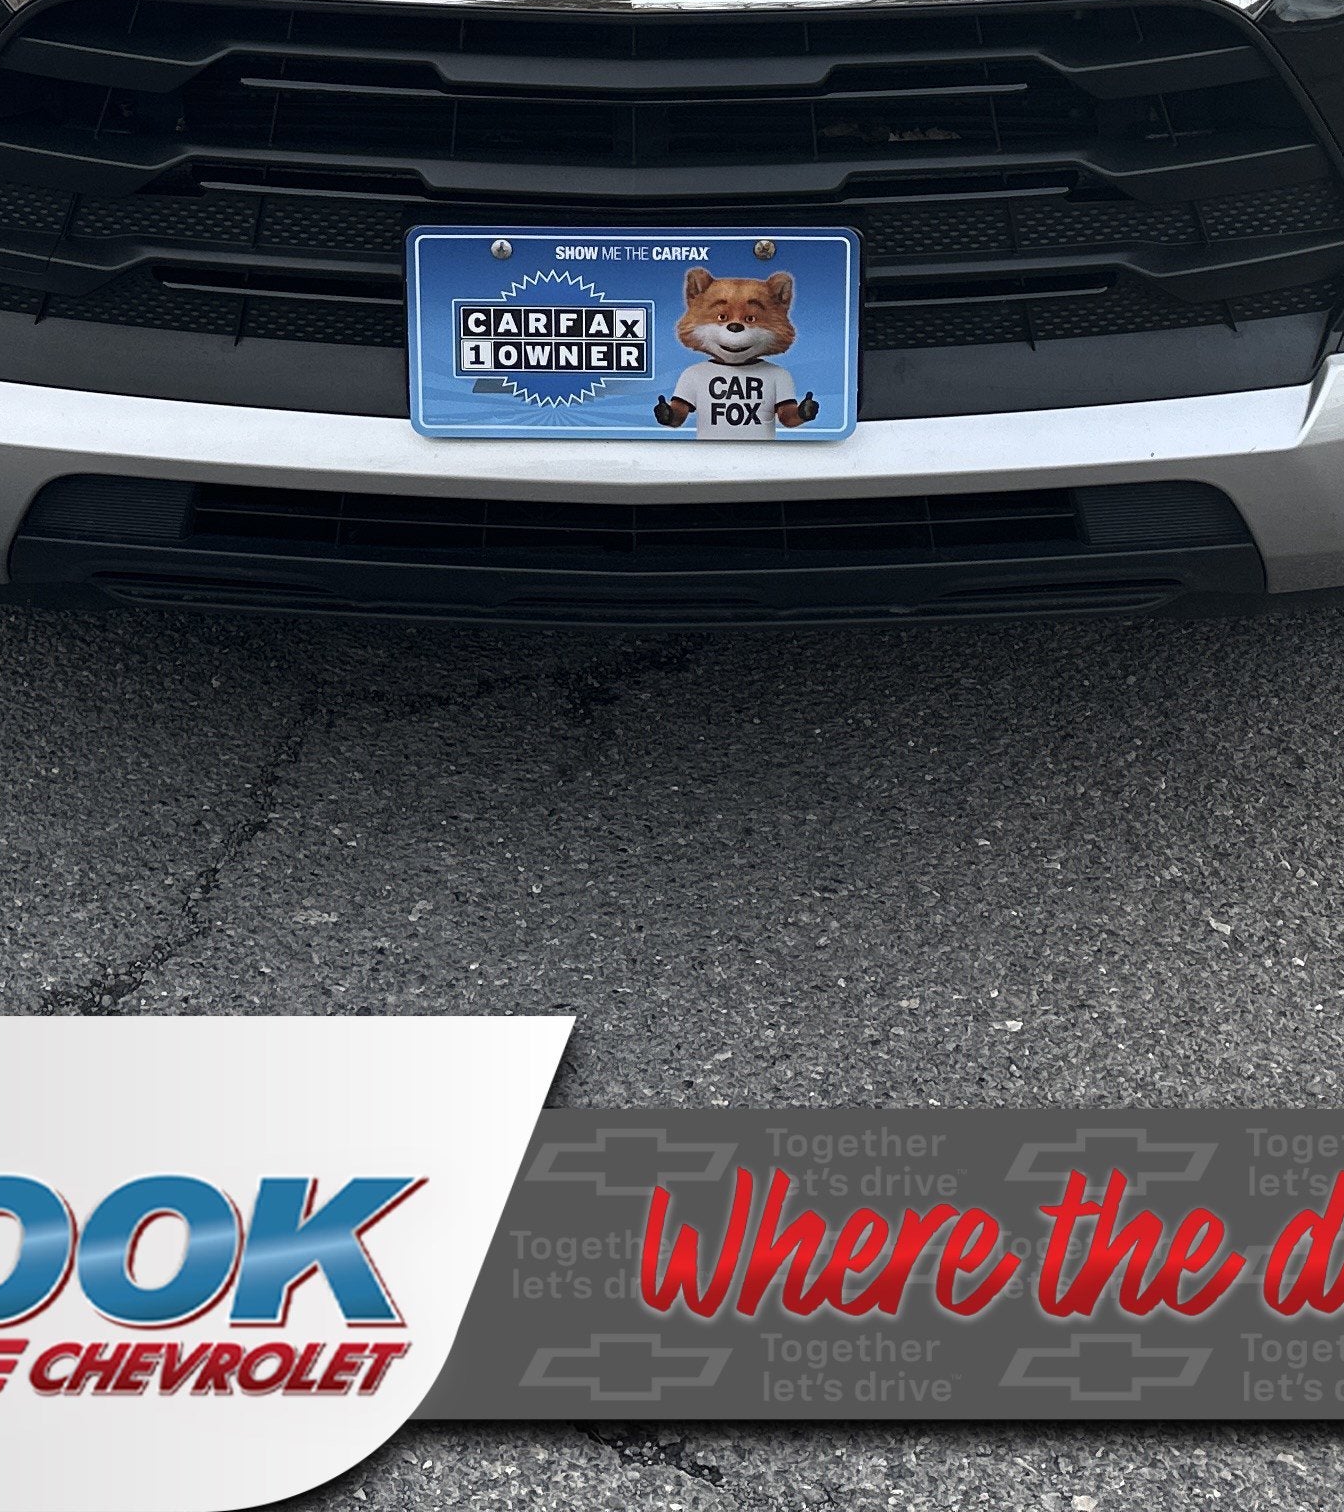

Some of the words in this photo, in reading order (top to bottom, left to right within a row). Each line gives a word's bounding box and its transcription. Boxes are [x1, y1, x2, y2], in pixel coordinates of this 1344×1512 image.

[555, 245, 598, 261] SHOW
[601, 245, 623, 261] ME
[625, 245, 650, 261] THE
[652, 245, 709, 261] CARFAX
[467, 313, 642, 339] CARFAX
[708, 375, 765, 402] CAR
[710, 402, 763, 426] FOX
